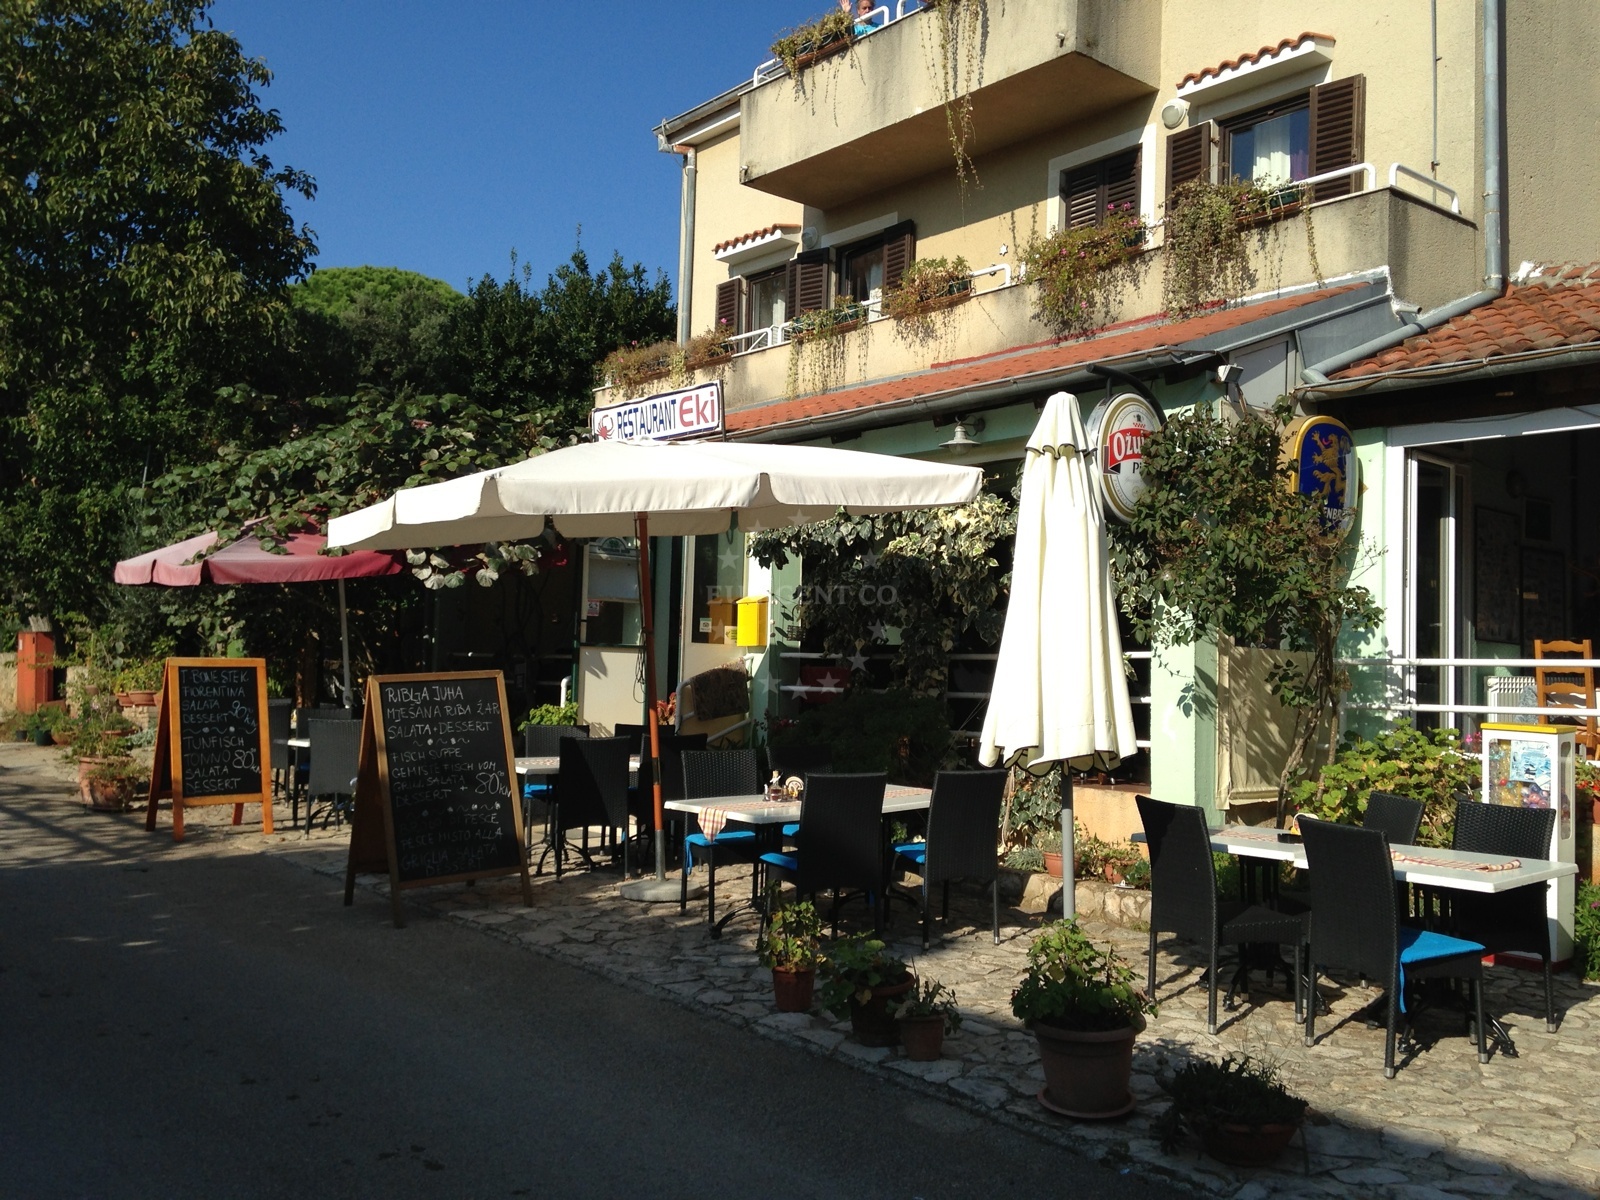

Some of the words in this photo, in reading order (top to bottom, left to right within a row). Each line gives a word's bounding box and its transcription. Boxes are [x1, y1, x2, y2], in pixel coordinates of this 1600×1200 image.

[617, 398, 676, 440] RESTAURANT
[679, 391, 716, 427] Eki
[182, 686, 246, 698] FIORENTINA
[386, 687, 430, 704] RIBLJA
[432, 686, 464, 701] JUHA
[182, 699, 220, 711] SALATA
[444, 704, 472, 716] RIBA
[182, 712, 228, 724] DESSERT
[388, 724, 432, 740] SALATA
[438, 721, 492, 735] DESSERT
[182, 736, 244, 750] TUNFISCH
[184, 750, 231, 767] TONNO
[391, 751, 426, 763] FISCH
[428, 748, 463, 760] SUPPE
[185, 765, 229, 780] SALATA
[478, 760, 496, 771] VOM
[186, 778, 242, 794] DESSERT
[426, 775, 466, 786] SALATA
[396, 789, 452, 807] DESSERT
[475, 772, 500, 794] 80
[464, 813, 500, 825] PESCE
[401, 832, 434, 850] PESCE
[438, 830, 471, 842] MISTO
[475, 826, 504, 840] ALLA
[402, 850, 448, 871] GRIGLIA
